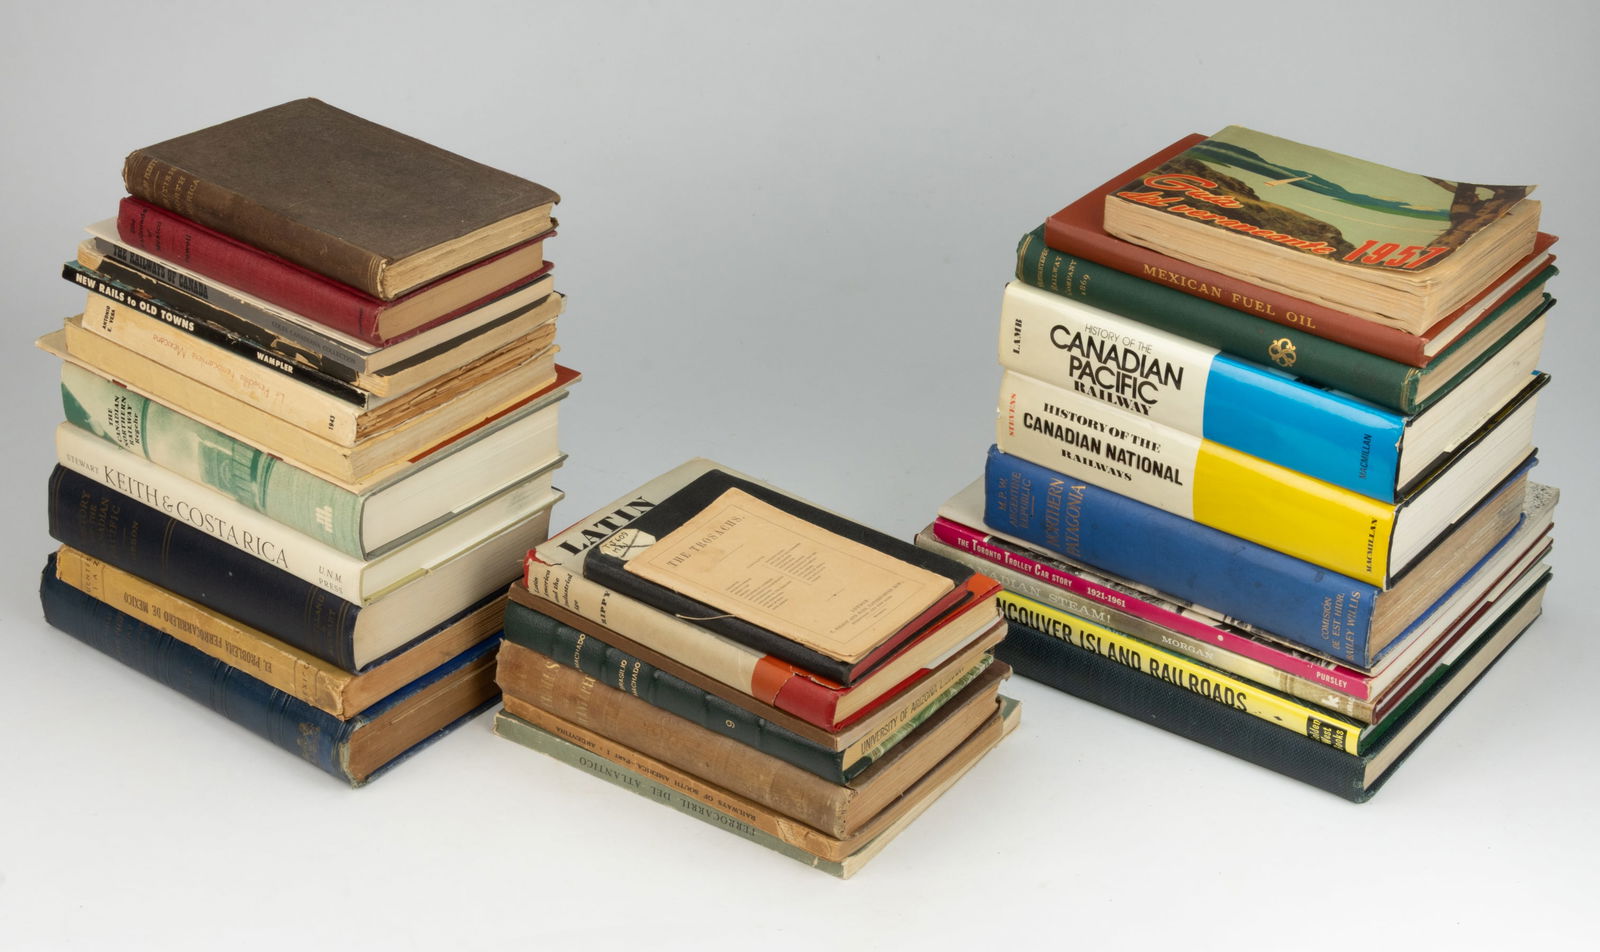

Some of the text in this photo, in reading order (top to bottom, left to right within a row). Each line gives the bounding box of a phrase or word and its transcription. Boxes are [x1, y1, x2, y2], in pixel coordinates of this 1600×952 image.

[1116, 190, 1451, 271] del veraneante 1957
[113, 244, 210, 300] THE RAILWAYS OF CANADA
[102, 305, 111, 330] ANTONIO
[1143, 263, 1318, 330] MEXICAN FUEL OIL
[75, 272, 294, 375] NEW RAILS to OLD TOWNS WAMPLER
[1012, 317, 1023, 356] LAMB
[1084, 322, 1154, 355] HISTORY OF THE
[1049, 323, 1185, 392] CANADIAN
[1068, 356, 1160, 406] PACIFIC
[1007, 392, 1018, 438] STEVENS
[1074, 378, 1153, 417] RAILWAY
[119, 395, 128, 449] NORTHERN
[126, 404, 134, 449] RAILWAY
[133, 413, 141, 446] Regehr
[1043, 401, 1162, 454] HISTORY OF THE
[1022, 411, 1185, 487] CANADIAN NATIONAL
[1061, 448, 1133, 483] RAILWAYS
[1358, 433, 1373, 480] MACMILLAN
[66, 453, 290, 569] STEWART KEITH & COSTA RICA
[1008, 471, 1022, 529] ARGENTINE
[1018, 478, 1032, 530] REPUBLIC
[1045, 476, 1066, 549] NORTHERN
[1065, 483, 1087, 559] PATAGONIA
[558, 495, 658, 556] LATIN
[665, 513, 746, 569] THE TROSACHS.
[1365, 517, 1379, 574] MACMILLAN
[123, 591, 150, 614] MEXICO
[318, 577, 345, 595] PRESS
[600, 590, 612, 626] RIPPY
[1349, 590, 1363, 629] WILLIS
[151, 604, 162, 618] DE
[163, 610, 224, 649] FERROCARRILERO
[957, 536, 1349, 690] THE TORONTO TROLLEY CAR STORY 1921-1961 PURSLEY
[1048, 592, 1112, 624] STEAM!
[1160, 634, 1216, 661] MORGAN
[1320, 595, 1332, 641] COMISION
[1332, 615, 1341, 637] EST
[225, 641, 265, 671] PROBLEMA
[996, 596, 1249, 712] NCOUVER ISLAND RAILROADS
[556, 725, 597, 749] ARGENTINA
[860, 685, 939, 755] UNIVERSITY OF ARIZONA
[579, 755, 757, 839] FERROCARRIL DEL ATLANTICO
[674, 779, 700, 795] SOUTH
[703, 792, 714, 802] OF
[717, 800, 757, 822] RAILWAYS
